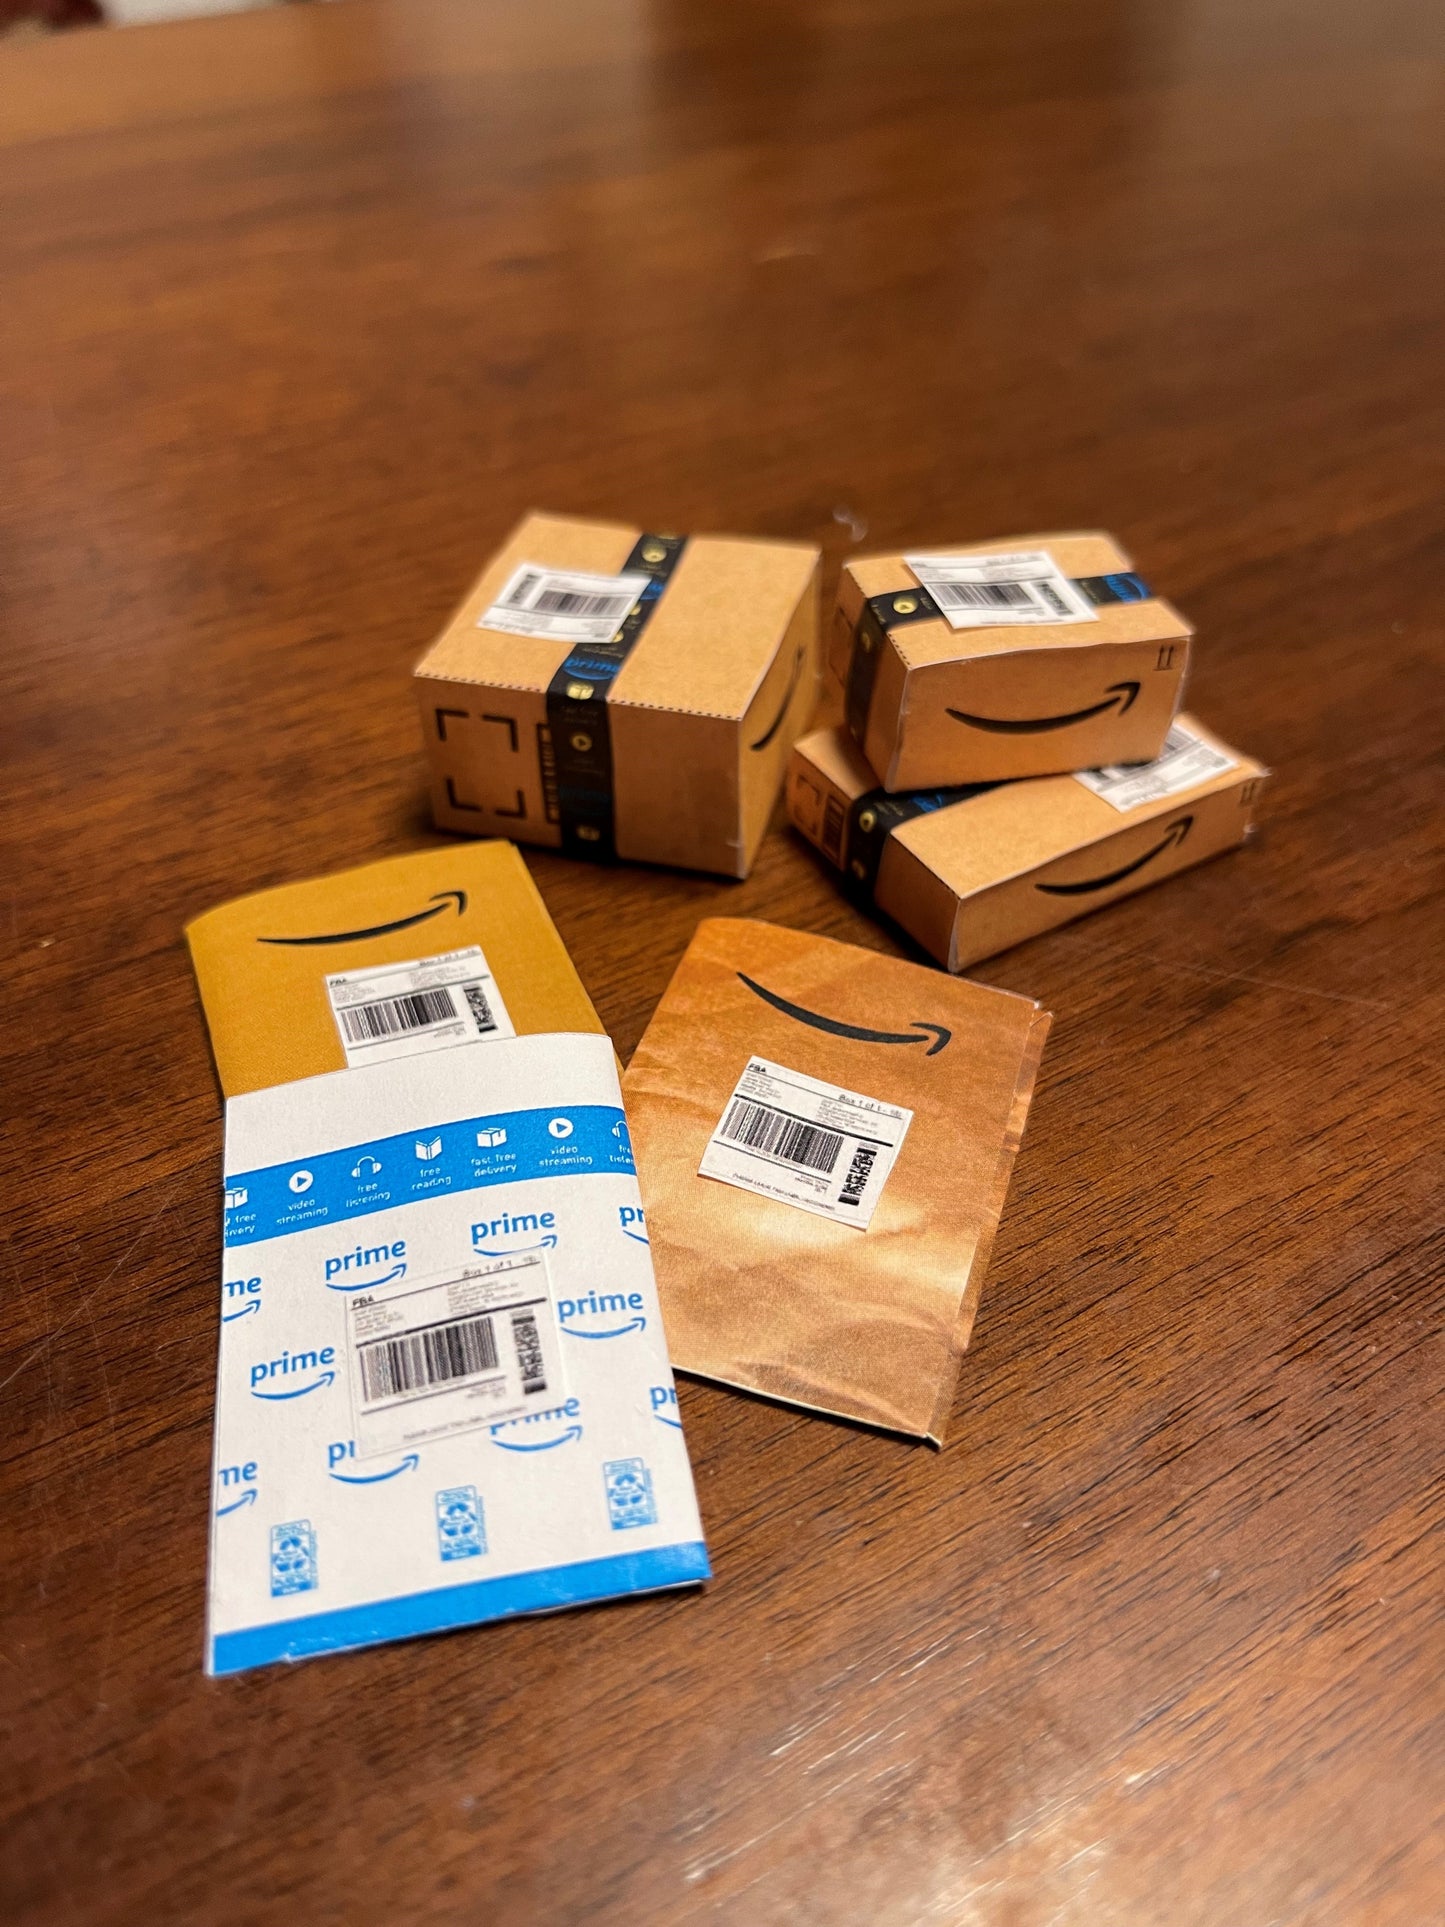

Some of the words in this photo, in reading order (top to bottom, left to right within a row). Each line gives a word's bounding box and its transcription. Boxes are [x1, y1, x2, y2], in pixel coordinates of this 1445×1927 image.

[551, 1144, 578, 1155] video
[470, 1156, 491, 1166] fast
[495, 1153, 517, 1163] free
[539, 1154, 593, 1167] streaming
[420, 1167, 441, 1178] free
[474, 1164, 517, 1177] delivery
[357, 1182, 378, 1194] free
[411, 1176, 452, 1190] reading
[288, 1198, 315, 1211] video
[345, 1191, 391, 1208] listening
[276, 1206, 329, 1225] streaming
[471, 1211, 556, 1245] prime
[325, 1240, 406, 1281] prime
[557, 1289, 644, 1323] prime
[251, 1346, 335, 1388] prime
